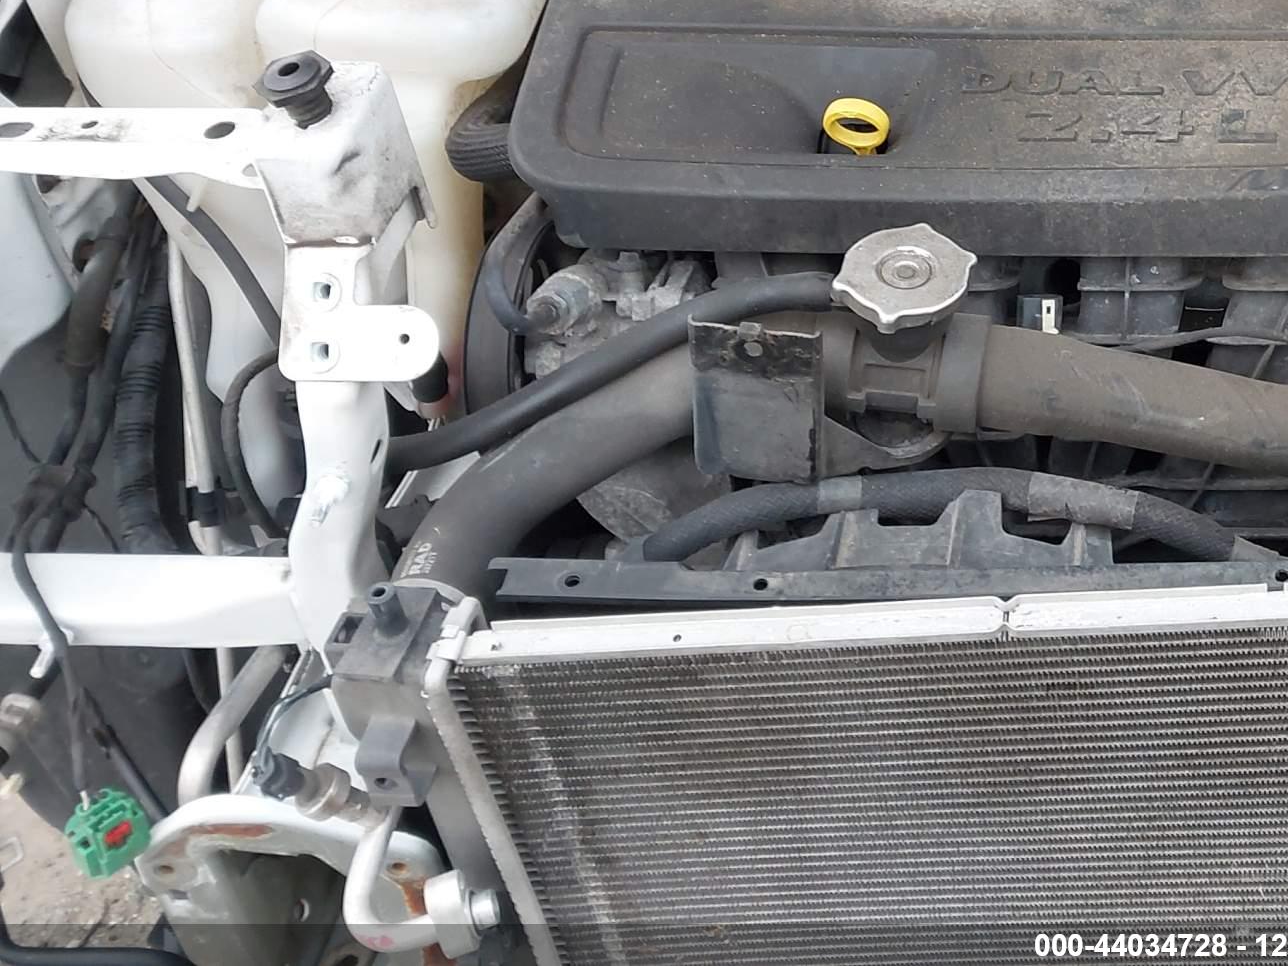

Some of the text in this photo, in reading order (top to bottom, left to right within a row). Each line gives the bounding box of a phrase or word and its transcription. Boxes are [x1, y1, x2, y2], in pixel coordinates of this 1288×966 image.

[961, 69, 1165, 96] DUAL
[1017, 110, 1278, 144] 2.4L
[408, 542, 432, 575] RAD
